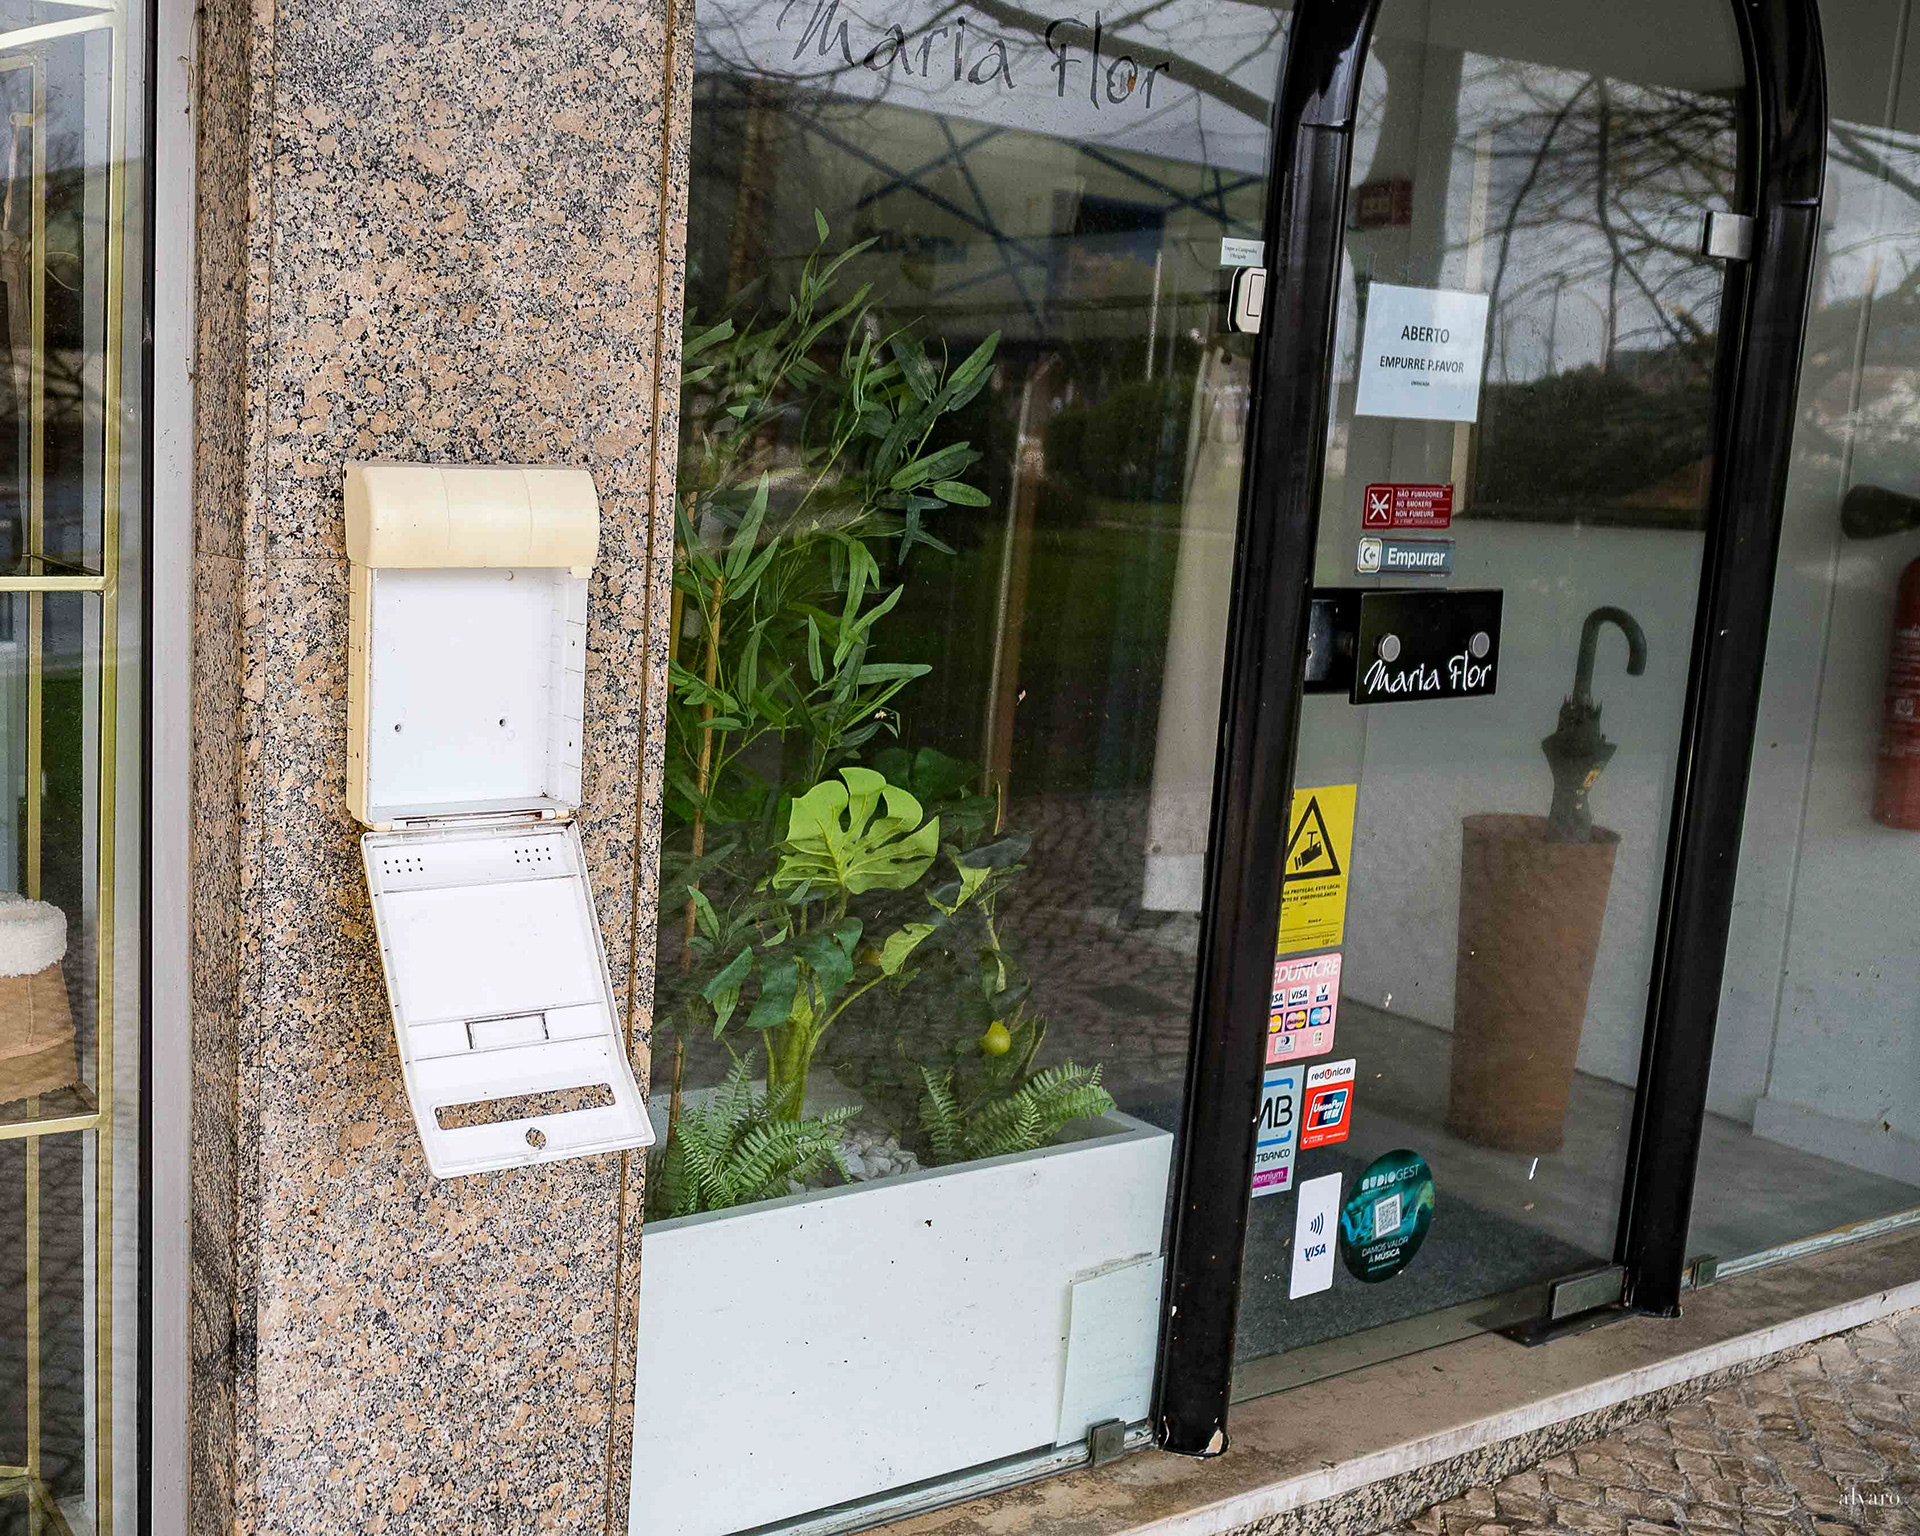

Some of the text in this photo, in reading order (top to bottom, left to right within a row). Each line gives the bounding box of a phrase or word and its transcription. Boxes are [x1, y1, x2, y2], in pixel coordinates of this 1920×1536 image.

[776, 0, 1170, 110] Maria Flor
[1400, 325, 1450, 343] ABERTO
[1379, 355, 1464, 373] EMPURRE P.FAVOR
[1397, 488, 1443, 498] NÃO FUMADORES
[1396, 500, 1432, 508] NO SMOKERS
[1409, 510, 1434, 518] FUMEURS
[1387, 547, 1446, 569] Empurrar
[1364, 650, 1491, 695] Maria Flor
[1291, 989, 1308, 999] VISA
[1321, 984, 1327, 993] V
[1256, 1149, 1291, 1163] TIBANCO
[1361, 1163, 1420, 1191] AUDIOGEST
[1304, 1243, 1327, 1261] VISA
[1361, 1235, 1409, 1258] DAMOS VALOR
[1374, 1247, 1400, 1262] MÚSICA
